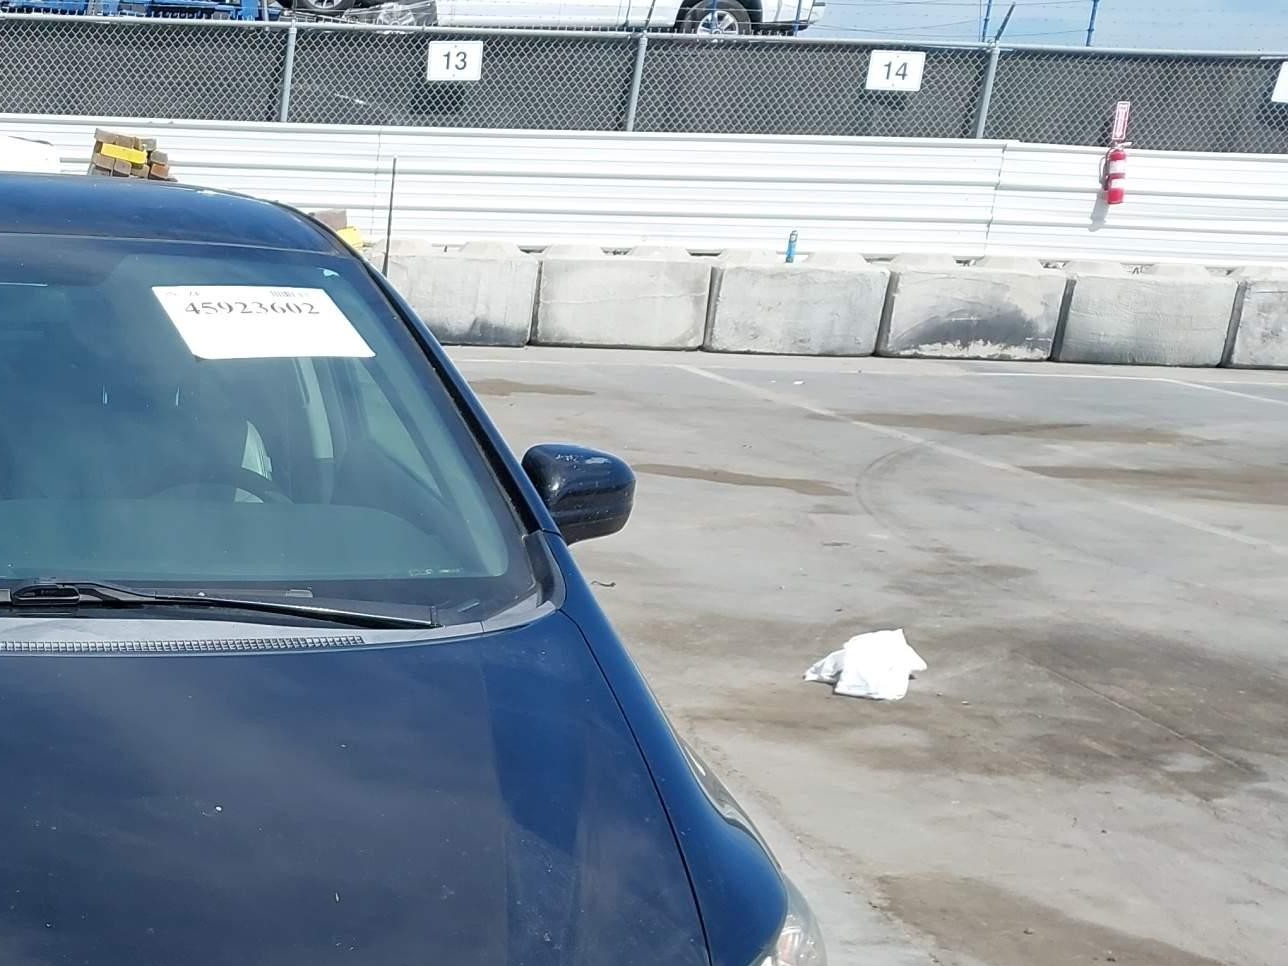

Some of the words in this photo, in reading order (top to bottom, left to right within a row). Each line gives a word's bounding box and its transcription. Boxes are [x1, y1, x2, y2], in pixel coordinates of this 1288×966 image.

[443, 51, 467, 71] 13
[883, 61, 908, 80] 14
[184, 301, 321, 315] 45923602
